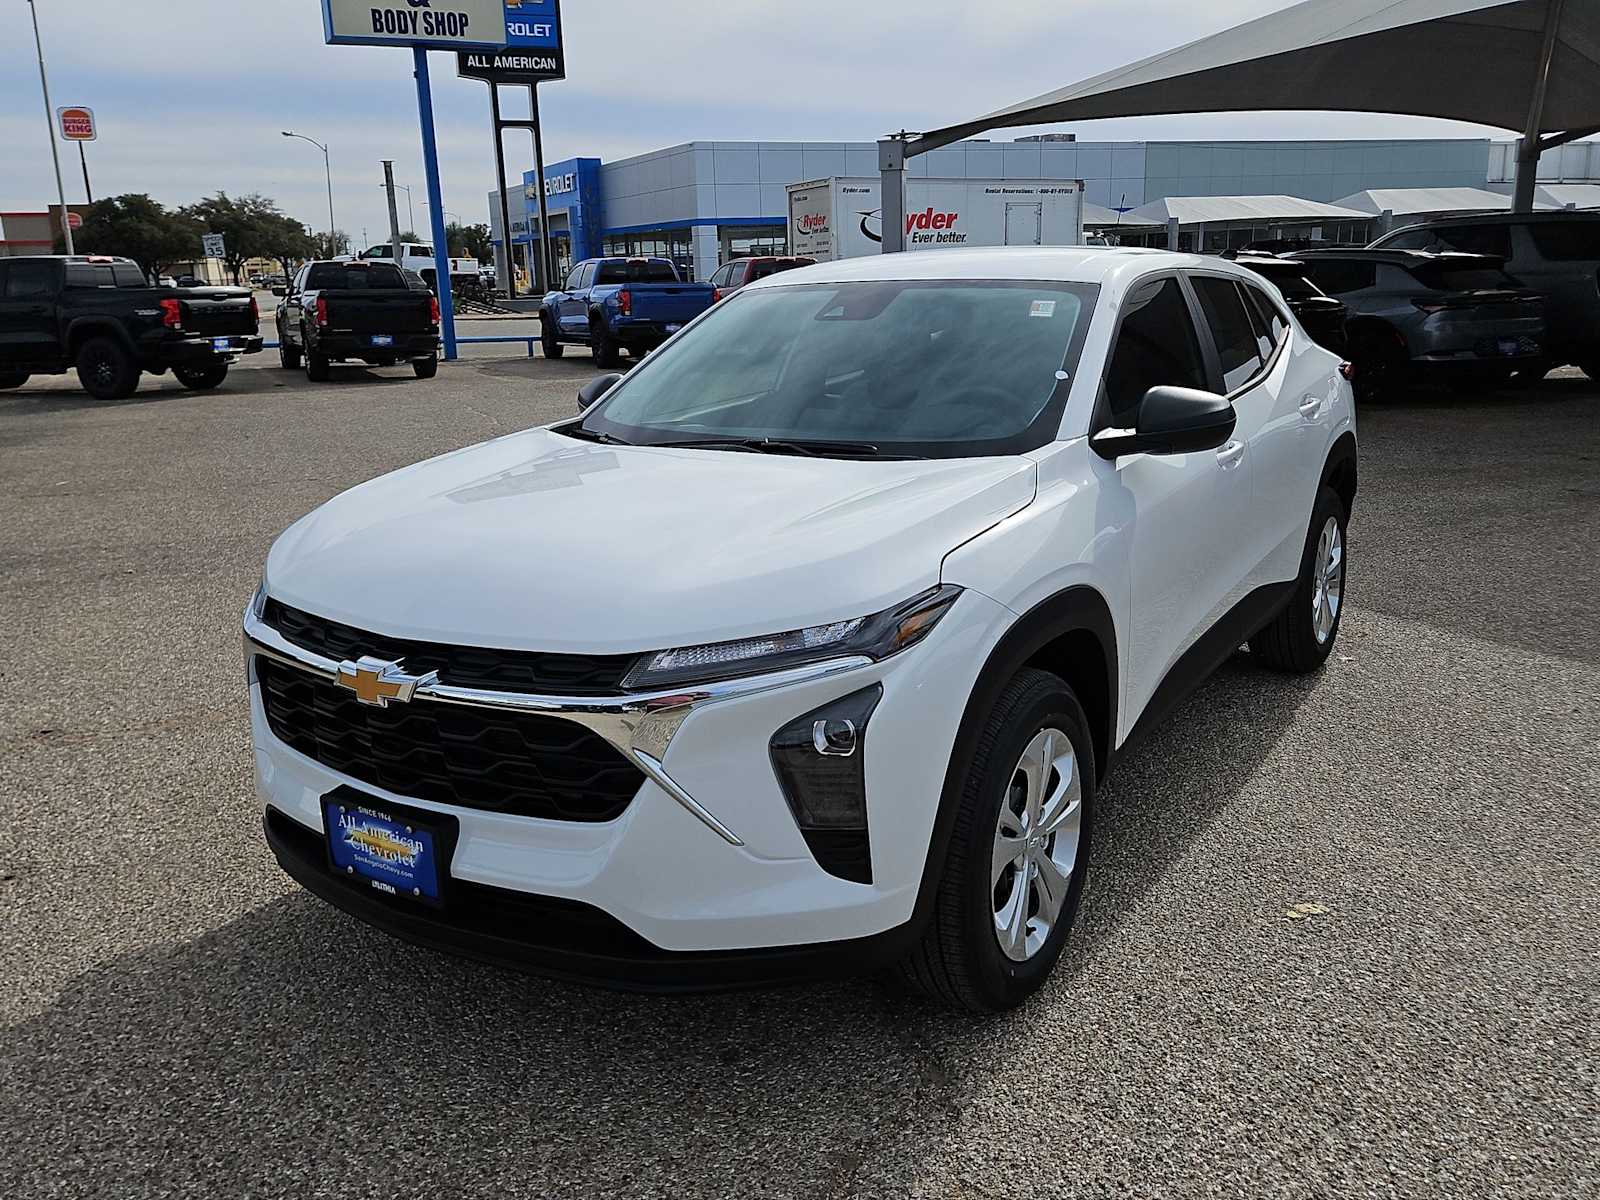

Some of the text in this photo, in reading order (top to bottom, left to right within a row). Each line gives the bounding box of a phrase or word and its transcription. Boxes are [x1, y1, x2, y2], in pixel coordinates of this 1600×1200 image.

[371, 8, 469, 37] BODY SHOP
[467, 54, 557, 70] ALL AMERICAN
[64, 124, 92, 133] KING
[803, 212, 827, 229] Ryder
[912, 231, 967, 243] Ever better.
[207, 246, 224, 257] 35
[358, 806, 377, 817] SINCE
[338, 814, 424, 853] All American
[350, 833, 416, 869] Chevrolet
